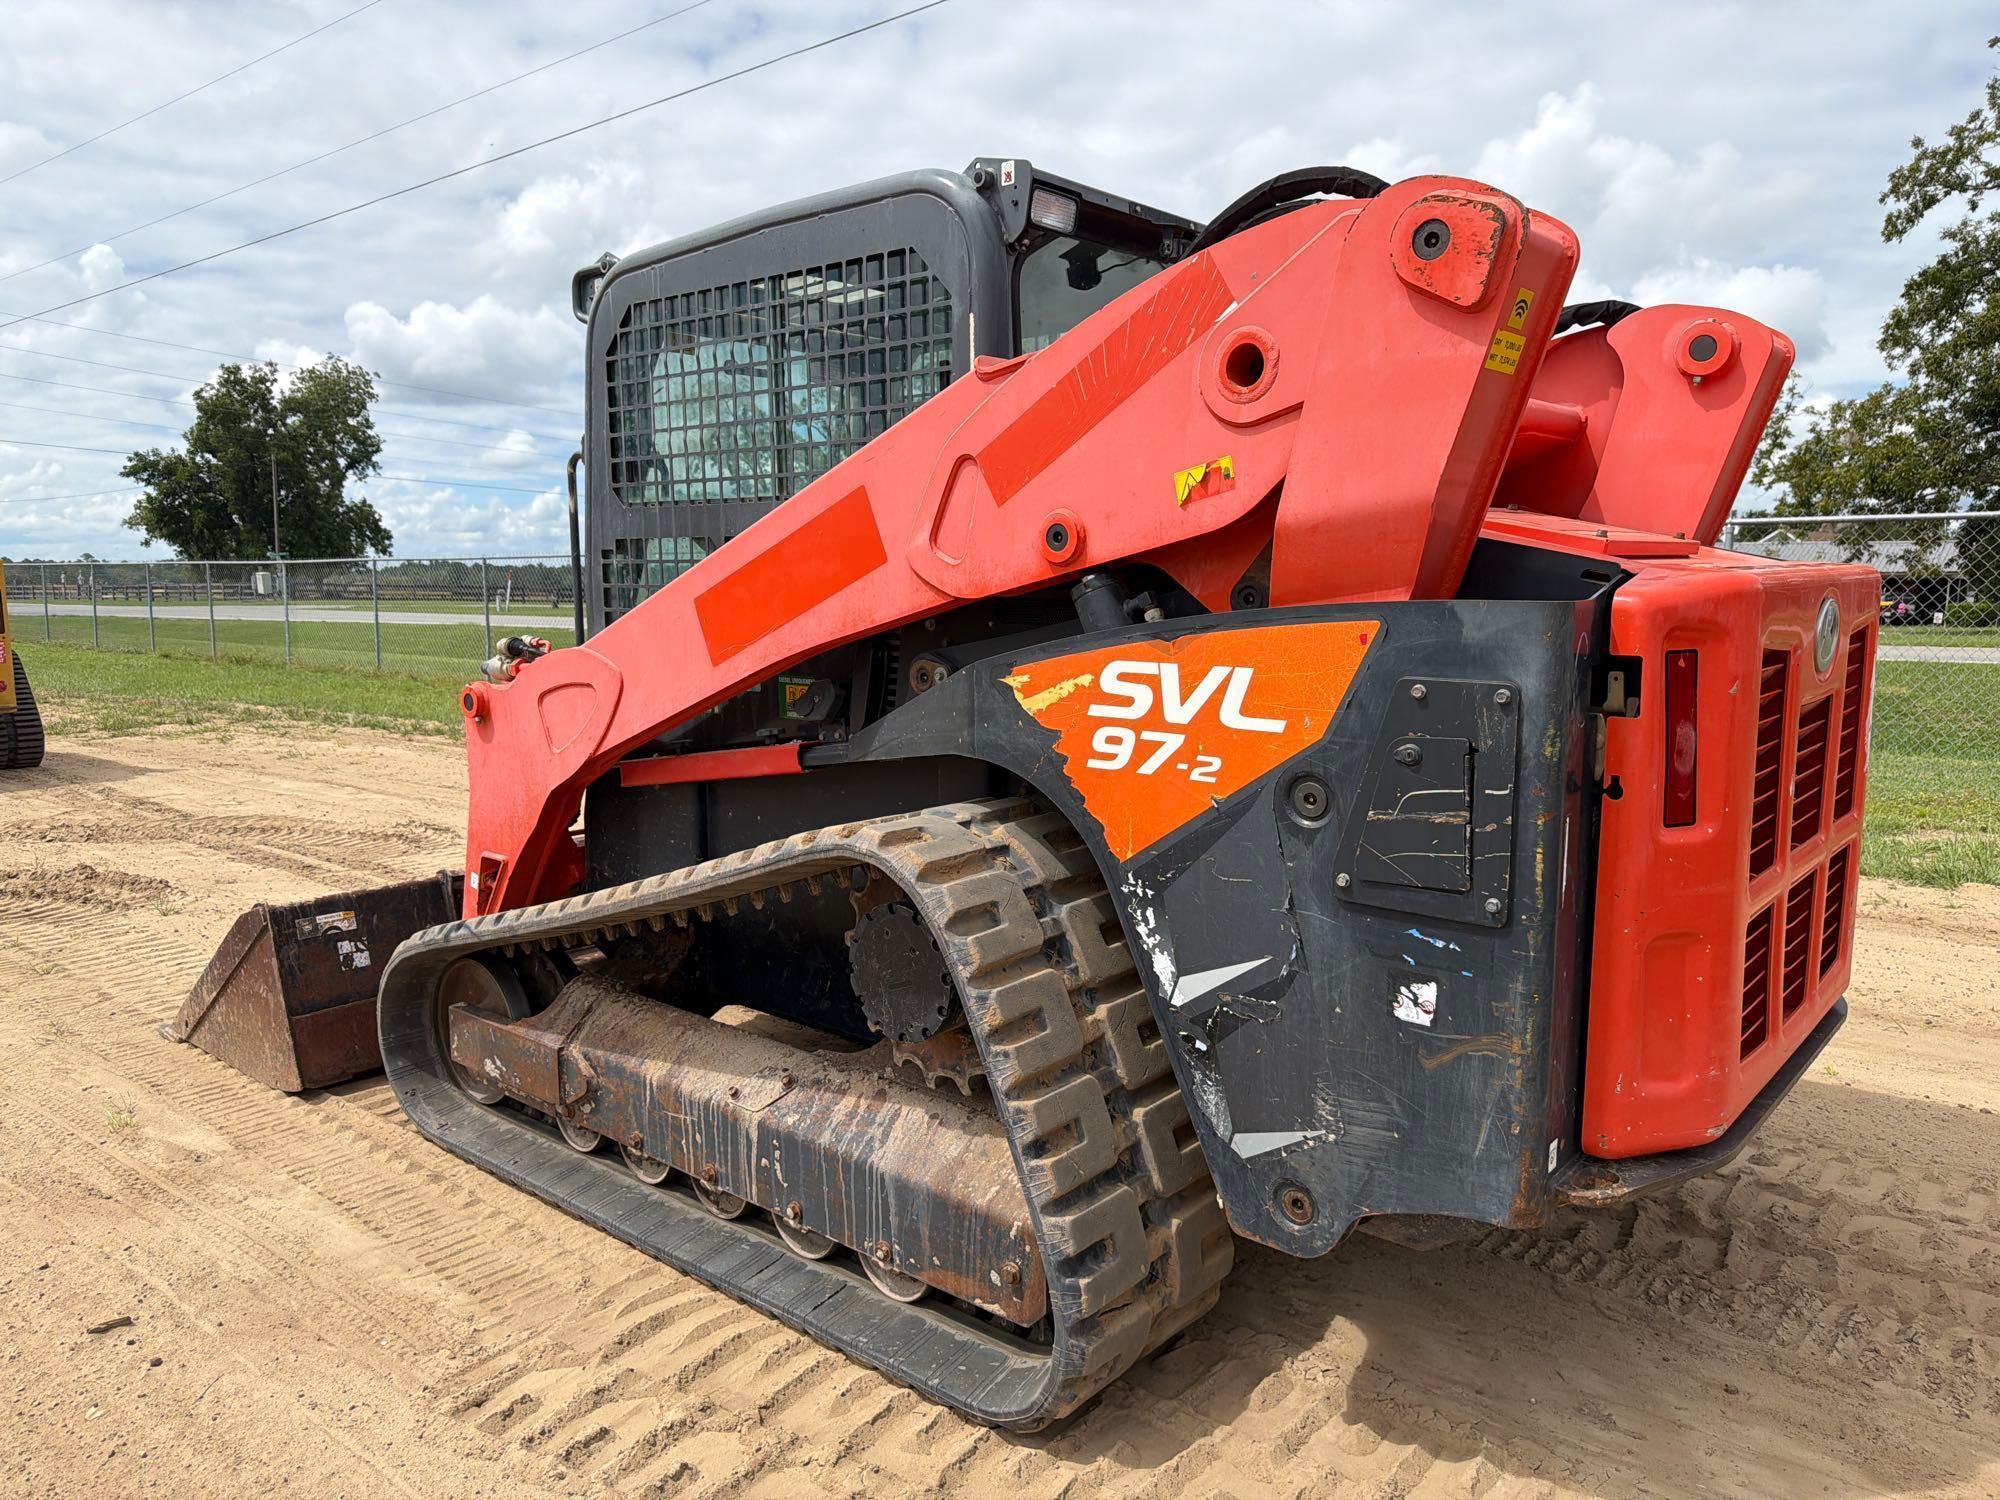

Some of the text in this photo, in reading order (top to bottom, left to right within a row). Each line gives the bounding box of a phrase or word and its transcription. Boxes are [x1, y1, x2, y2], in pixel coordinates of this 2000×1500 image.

[1490, 353, 1499, 362] WET
[1087, 660, 1287, 734] SVL
[1086, 726, 1222, 784] 97-2
